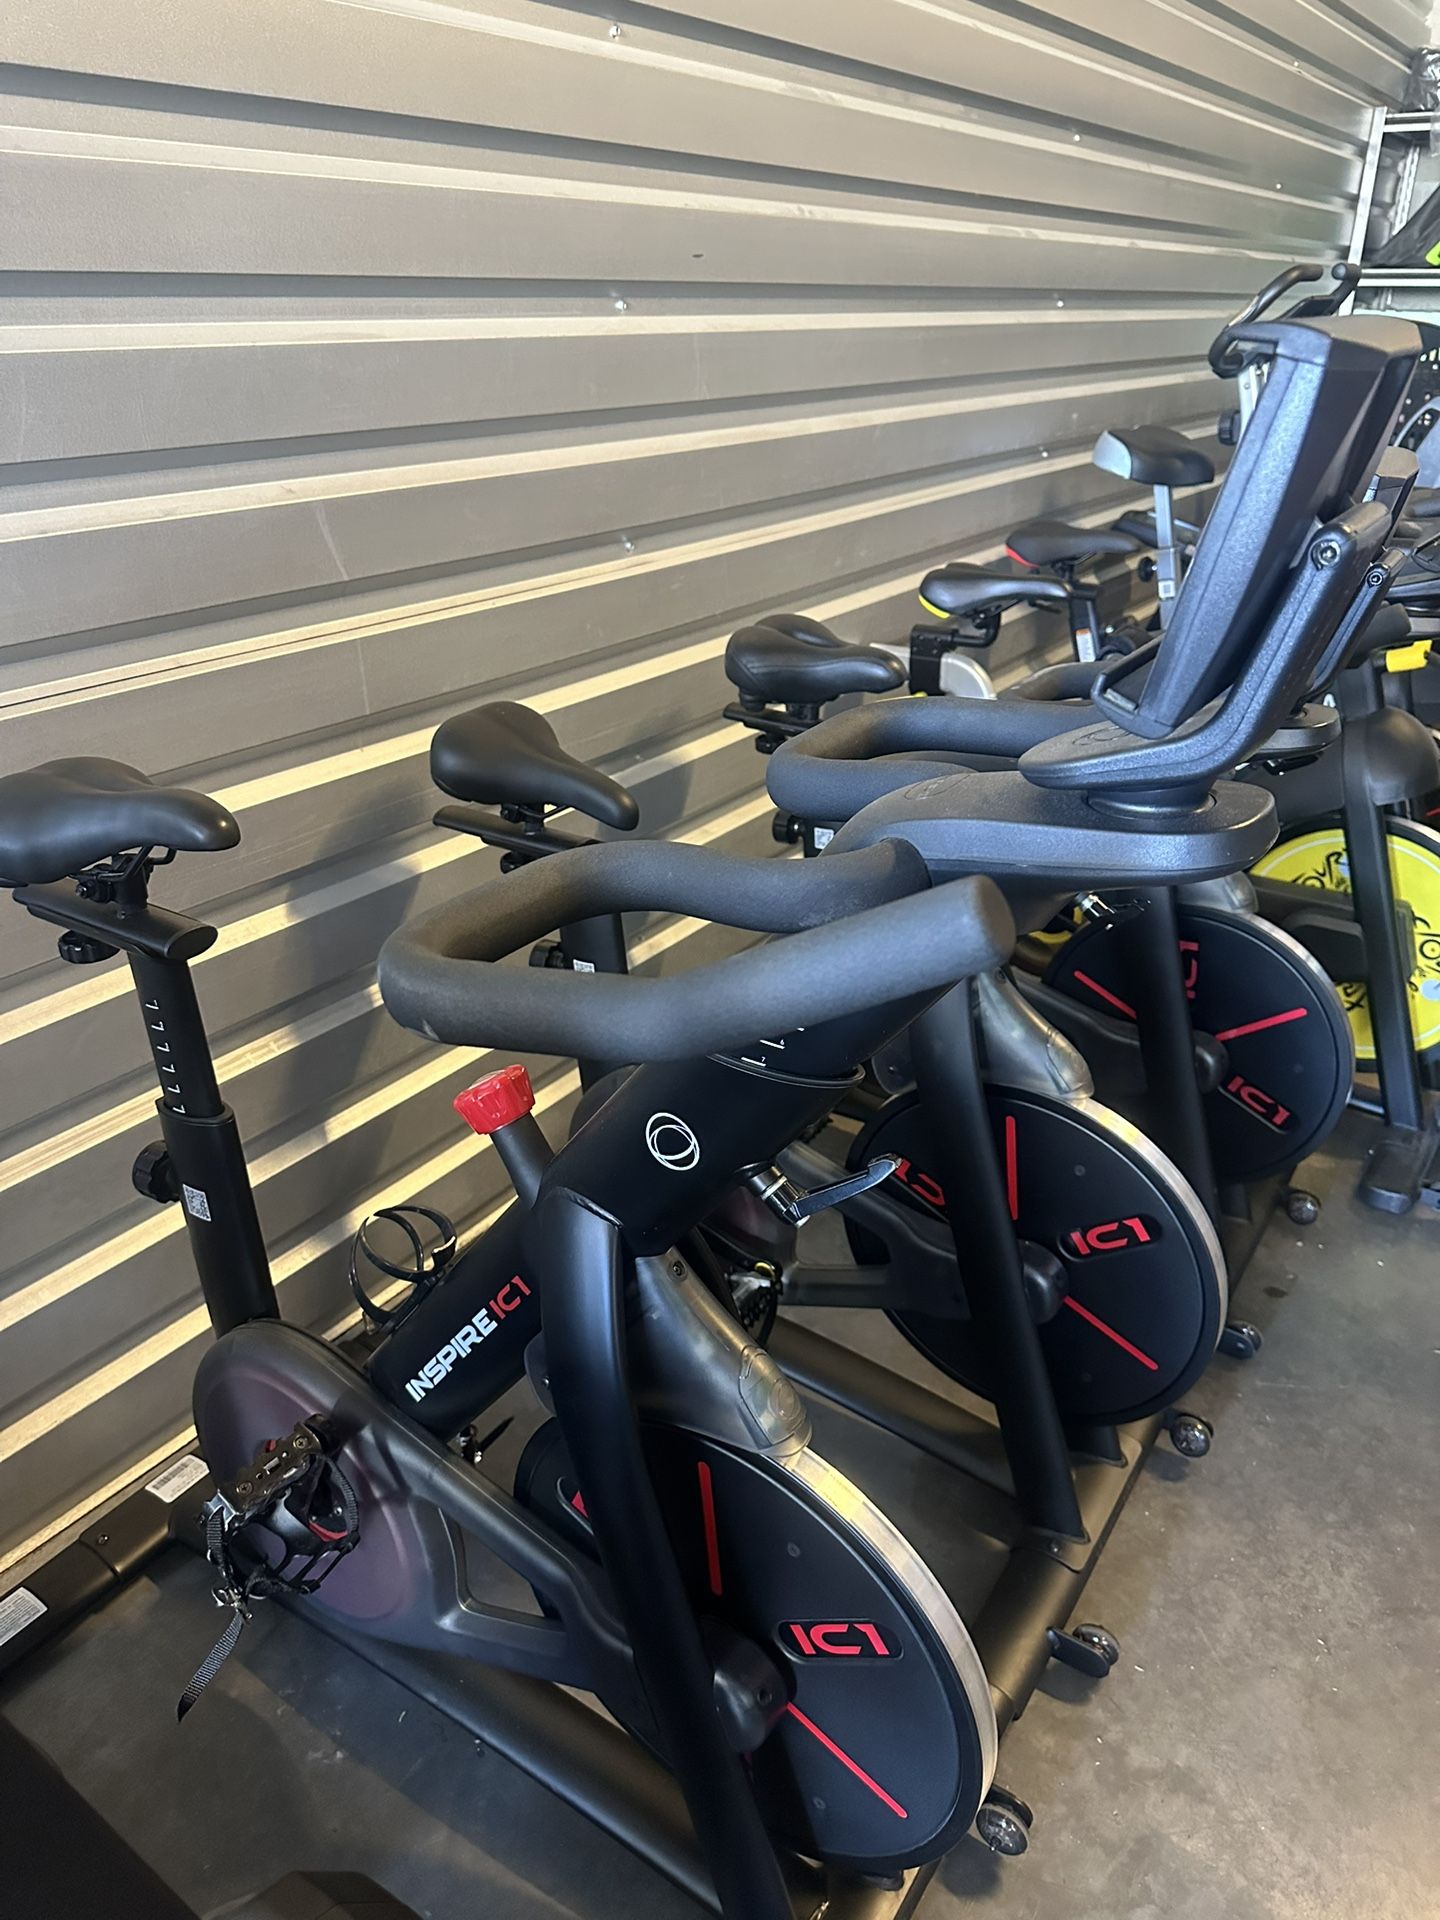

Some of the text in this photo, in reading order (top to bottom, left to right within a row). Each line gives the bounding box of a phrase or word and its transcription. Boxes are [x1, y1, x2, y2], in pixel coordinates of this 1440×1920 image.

[1227, 1075, 1291, 1126] IC1
[1070, 1216, 1151, 1256] IC1
[404, 1274, 532, 1403] INSPIRE IC1
[788, 1622, 891, 1656] IC1
